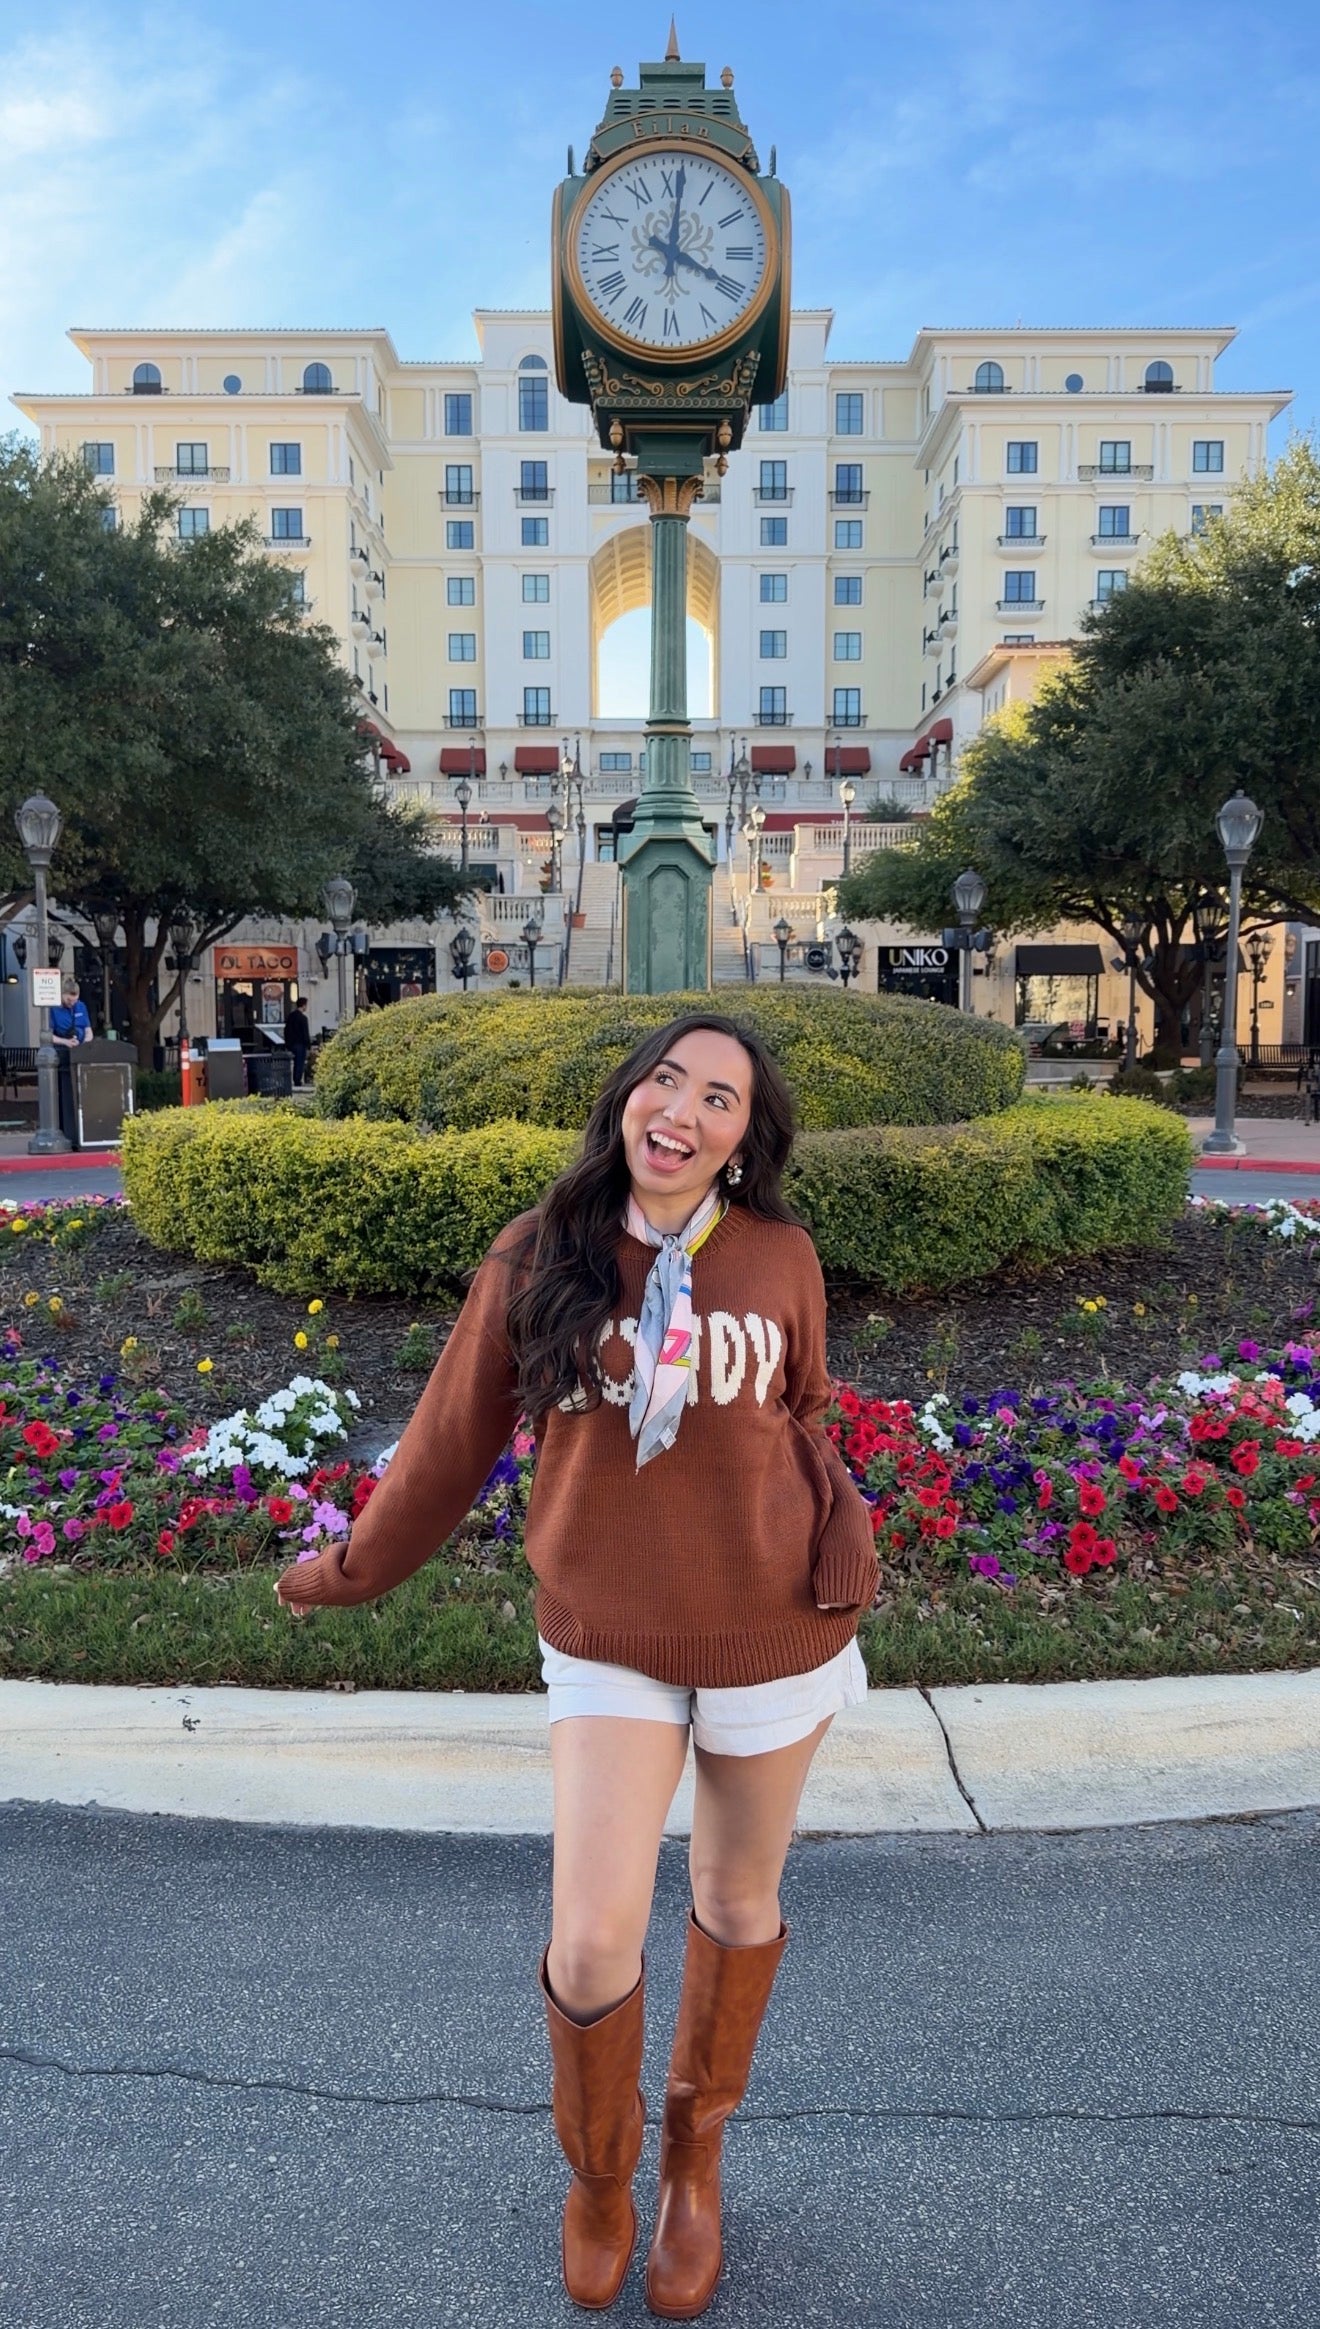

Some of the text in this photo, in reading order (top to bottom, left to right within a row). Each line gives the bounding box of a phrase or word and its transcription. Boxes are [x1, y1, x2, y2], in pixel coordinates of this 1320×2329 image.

[632, 116, 709, 138] Eilan
[625, 177, 652, 209] XI
[601, 206, 628, 230] X
[718, 209, 744, 228] II
[726, 247, 753, 260] III
[699, 302, 717, 328] V
[247, 955, 292, 969] TACO
[889, 948, 949, 966] UNIKO
